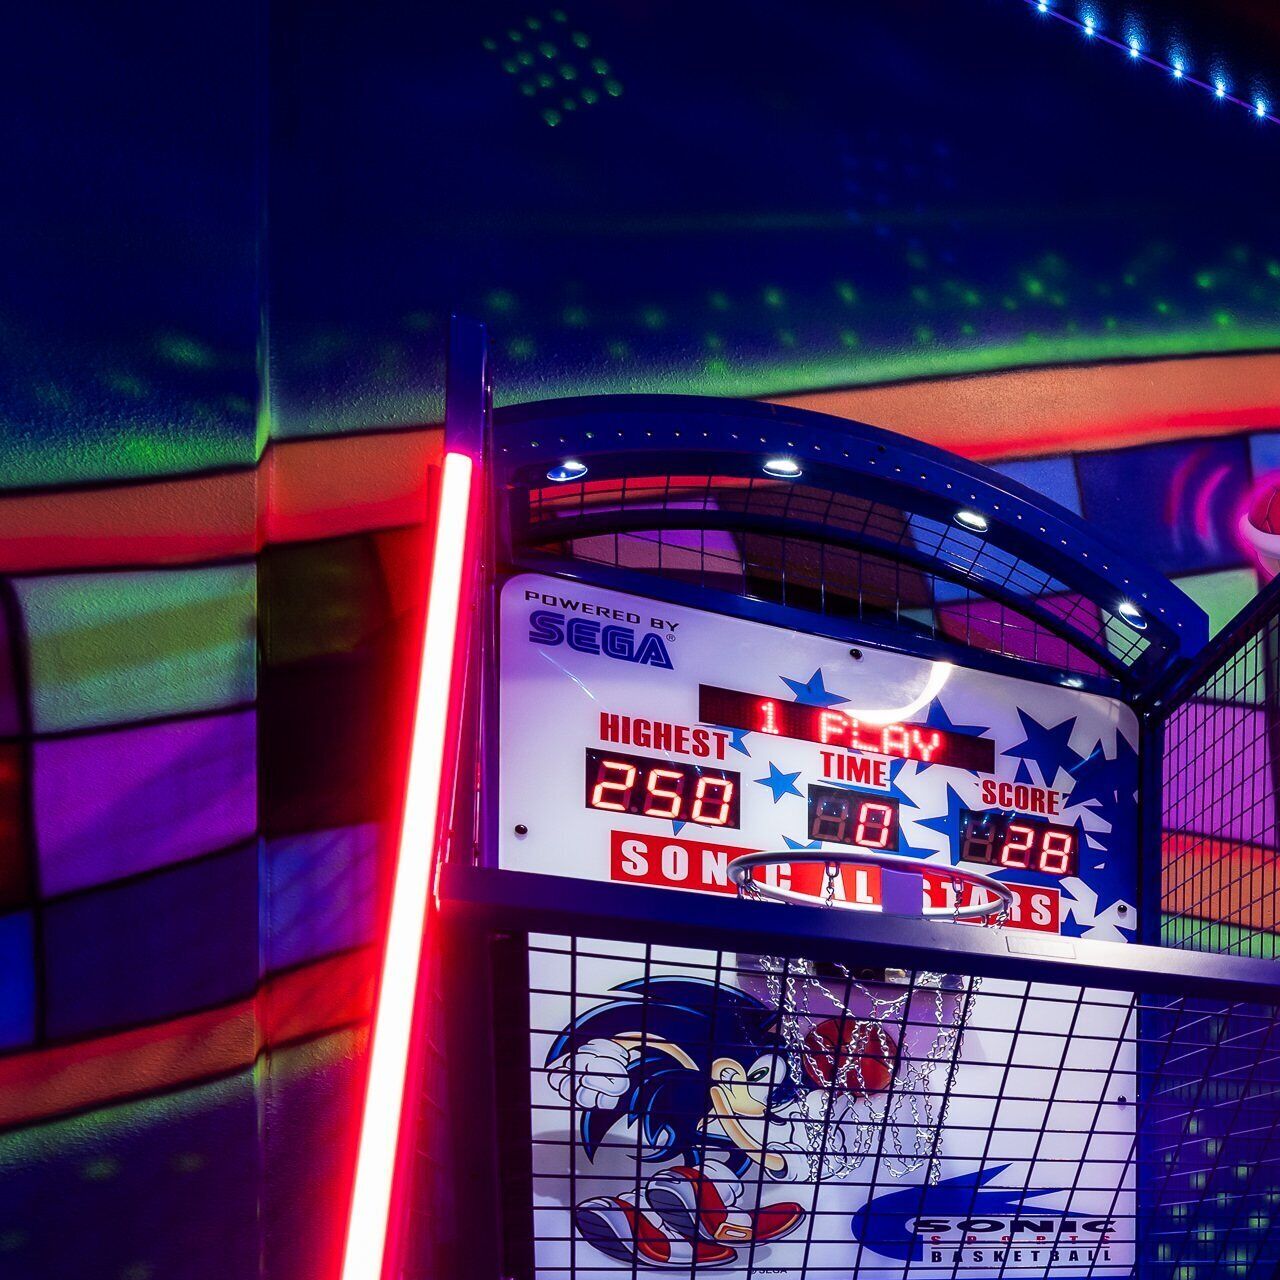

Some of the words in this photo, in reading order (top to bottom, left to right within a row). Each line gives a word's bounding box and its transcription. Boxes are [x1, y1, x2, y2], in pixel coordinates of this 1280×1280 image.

[525, 590, 641, 624] POWERED
[650, 617, 680, 632] BY
[529, 610, 675, 671] SEGA
[600, 712, 732, 762] HIGHEST
[759, 700, 779, 736] 1
[819, 709, 941, 761] PLAY
[591, 760, 734, 827] 250
[819, 750, 889, 788] TIME
[980, 778, 1063, 817] SCORE
[999, 825, 1073, 875] 28
[620, 838, 793, 891] SONC
[818, 861, 1052, 927] ALSTARS
[913, 1218, 1118, 1233] SONIC
[931, 1250, 1112, 1263] BASKETBALL
